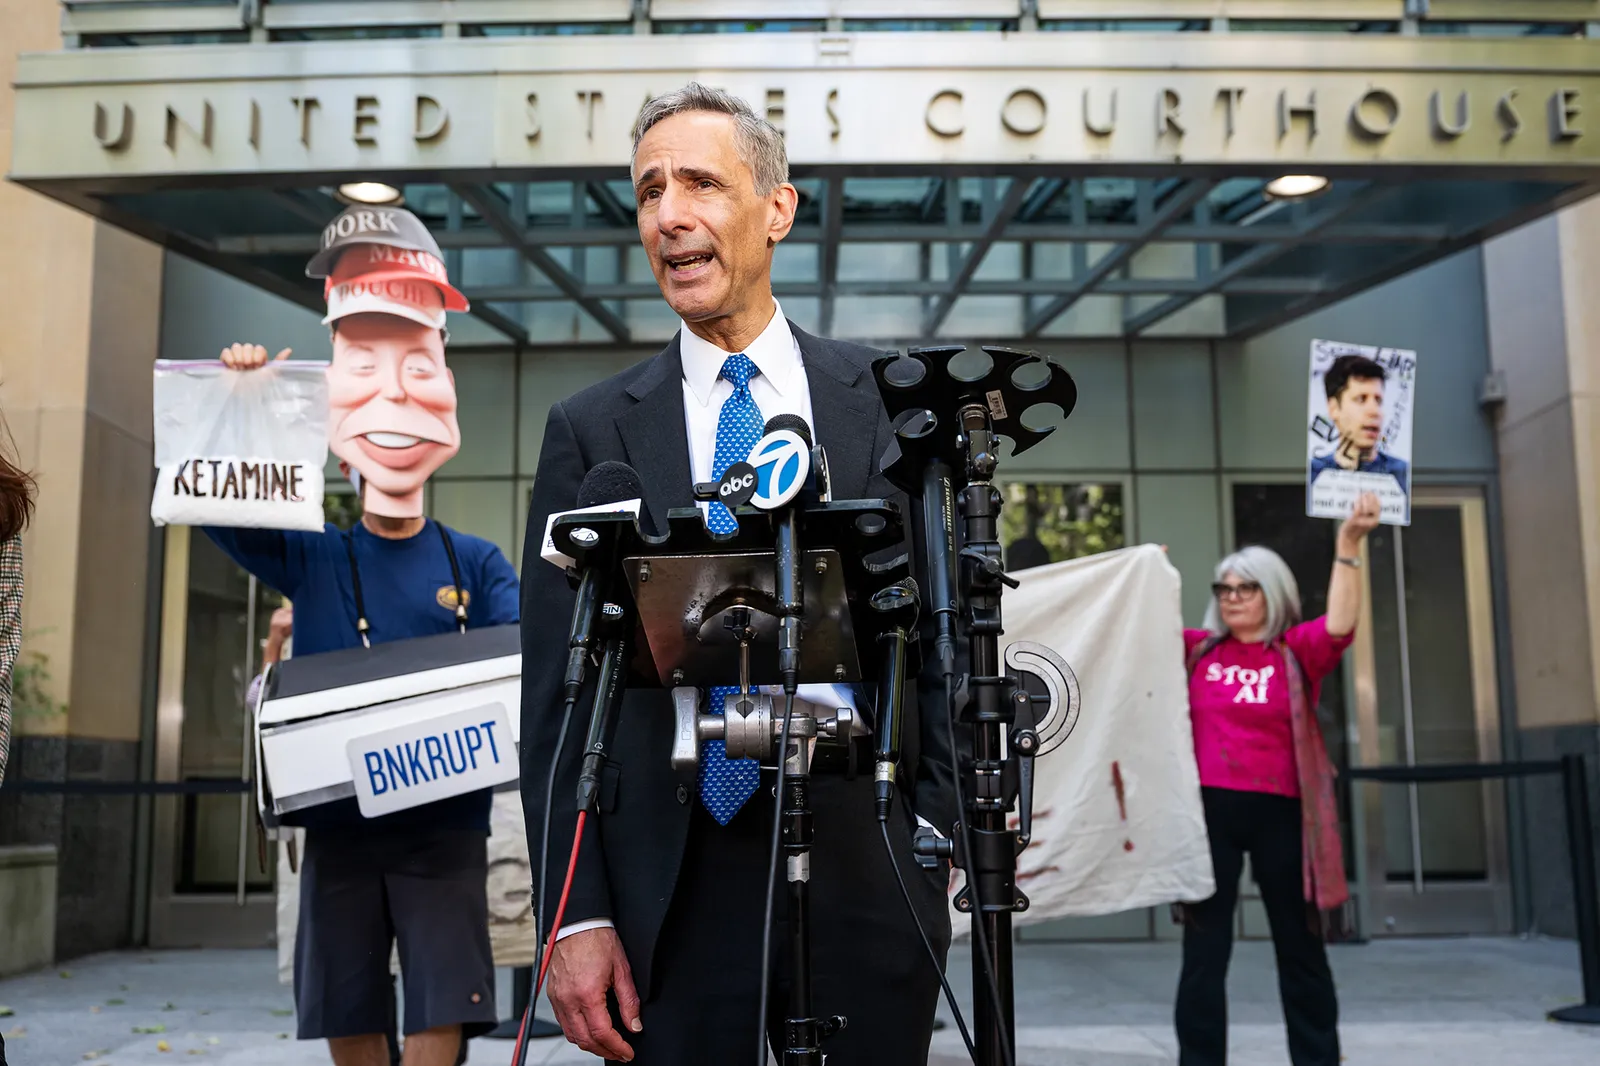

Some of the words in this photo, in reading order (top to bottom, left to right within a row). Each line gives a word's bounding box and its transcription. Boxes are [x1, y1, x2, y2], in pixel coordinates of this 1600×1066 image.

[94, 95, 450, 151] UNITED
[523, 89, 841, 142] STES
[924, 86, 1583, 144] COURTHOUSE
[322, 210, 400, 248] DORK
[173, 458, 305, 502] KETAMINE
[720, 472, 754, 497] abc
[1205, 662, 1275, 686] STOP
[1232, 684, 1269, 704] AI
[364, 721, 501, 796] BNKRUPT
